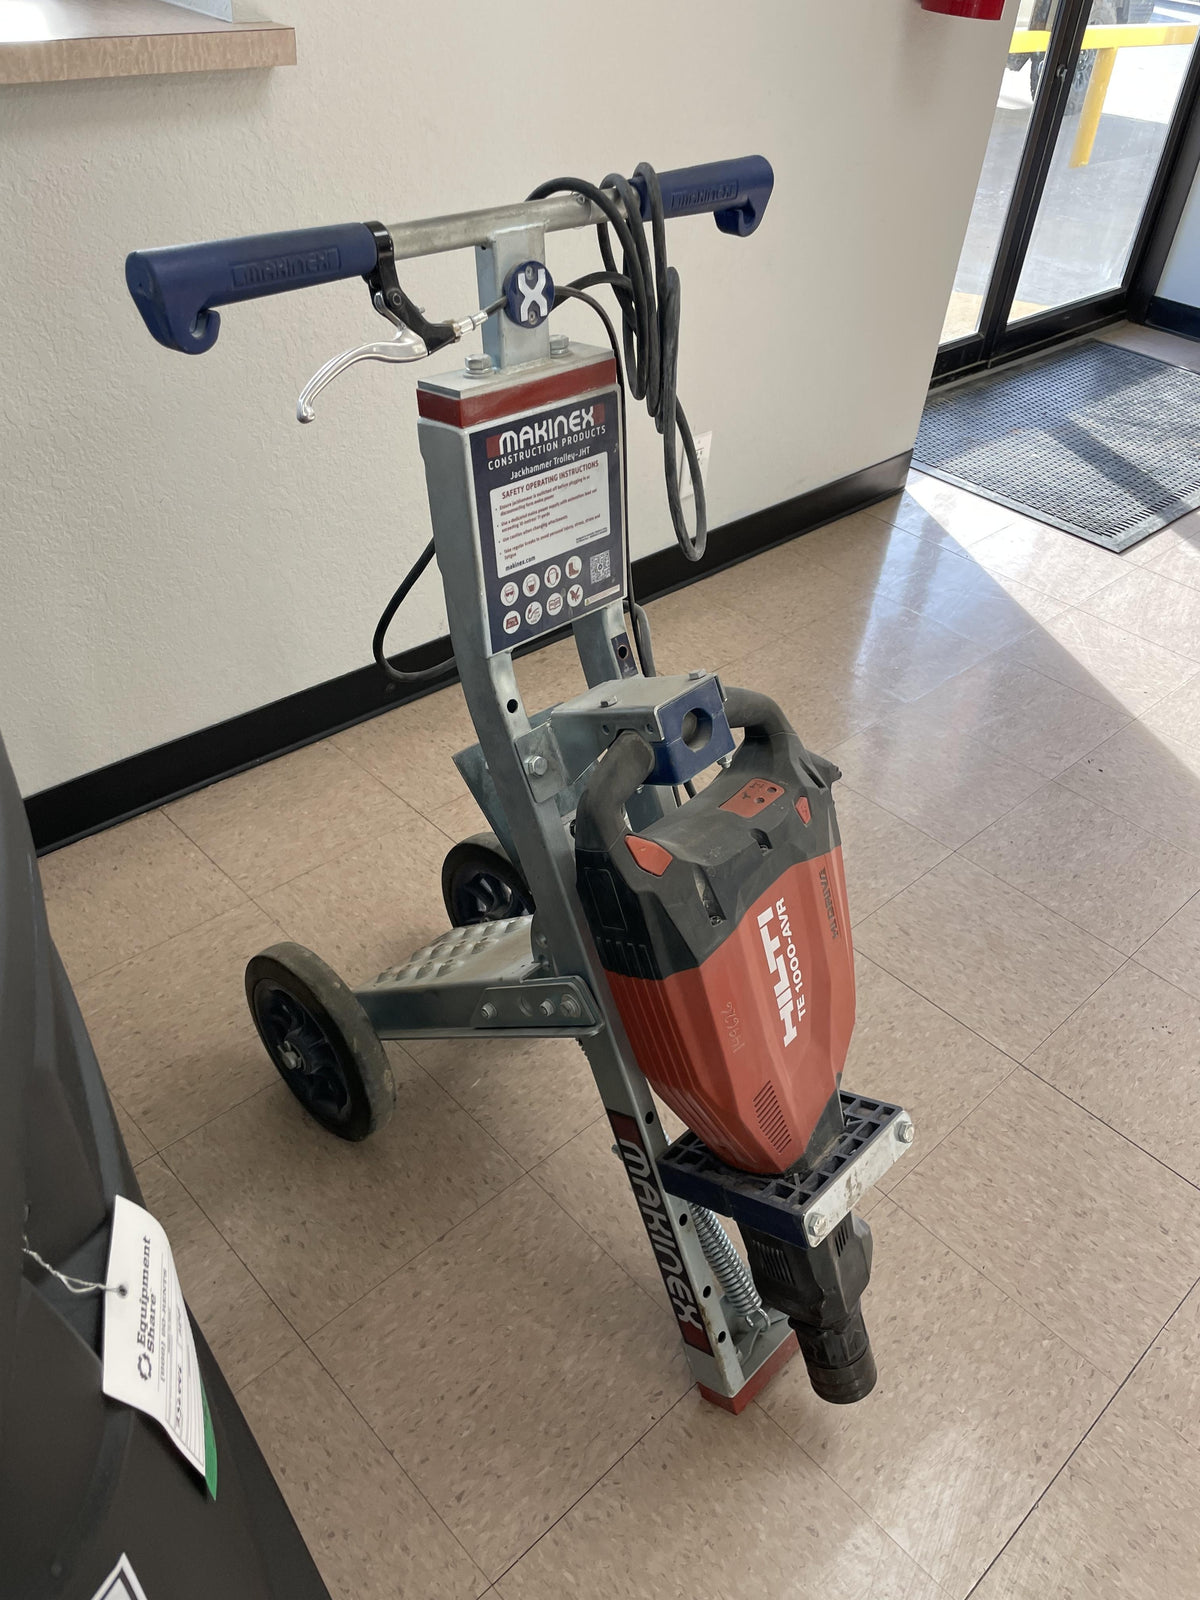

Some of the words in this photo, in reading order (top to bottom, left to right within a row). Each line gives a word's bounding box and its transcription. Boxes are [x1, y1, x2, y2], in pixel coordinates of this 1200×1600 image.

[488, 439, 559, 471] CONSTRUCTION
[561, 425, 606, 447] PRODUCTS
[499, 406, 594, 455] MAKINEX
[501, 484, 524, 499] SAFETY
[525, 473, 558, 491] OPERATING
[558, 459, 598, 480] INSTRUCTIONS
[510, 460, 553, 480] Jackhammer
[553, 446, 591, 465] Trolley-JHT
[505, 554, 535, 571] makinex.com
[775, 897, 803, 993] 1000-AVR
[757, 906, 797, 1048] HILTI
[796, 994, 806, 1022] TE
[619, 1138, 703, 1330] MAKINEX
[137, 1235, 151, 1348] Equipment
[147, 1293, 156, 1354] Share
